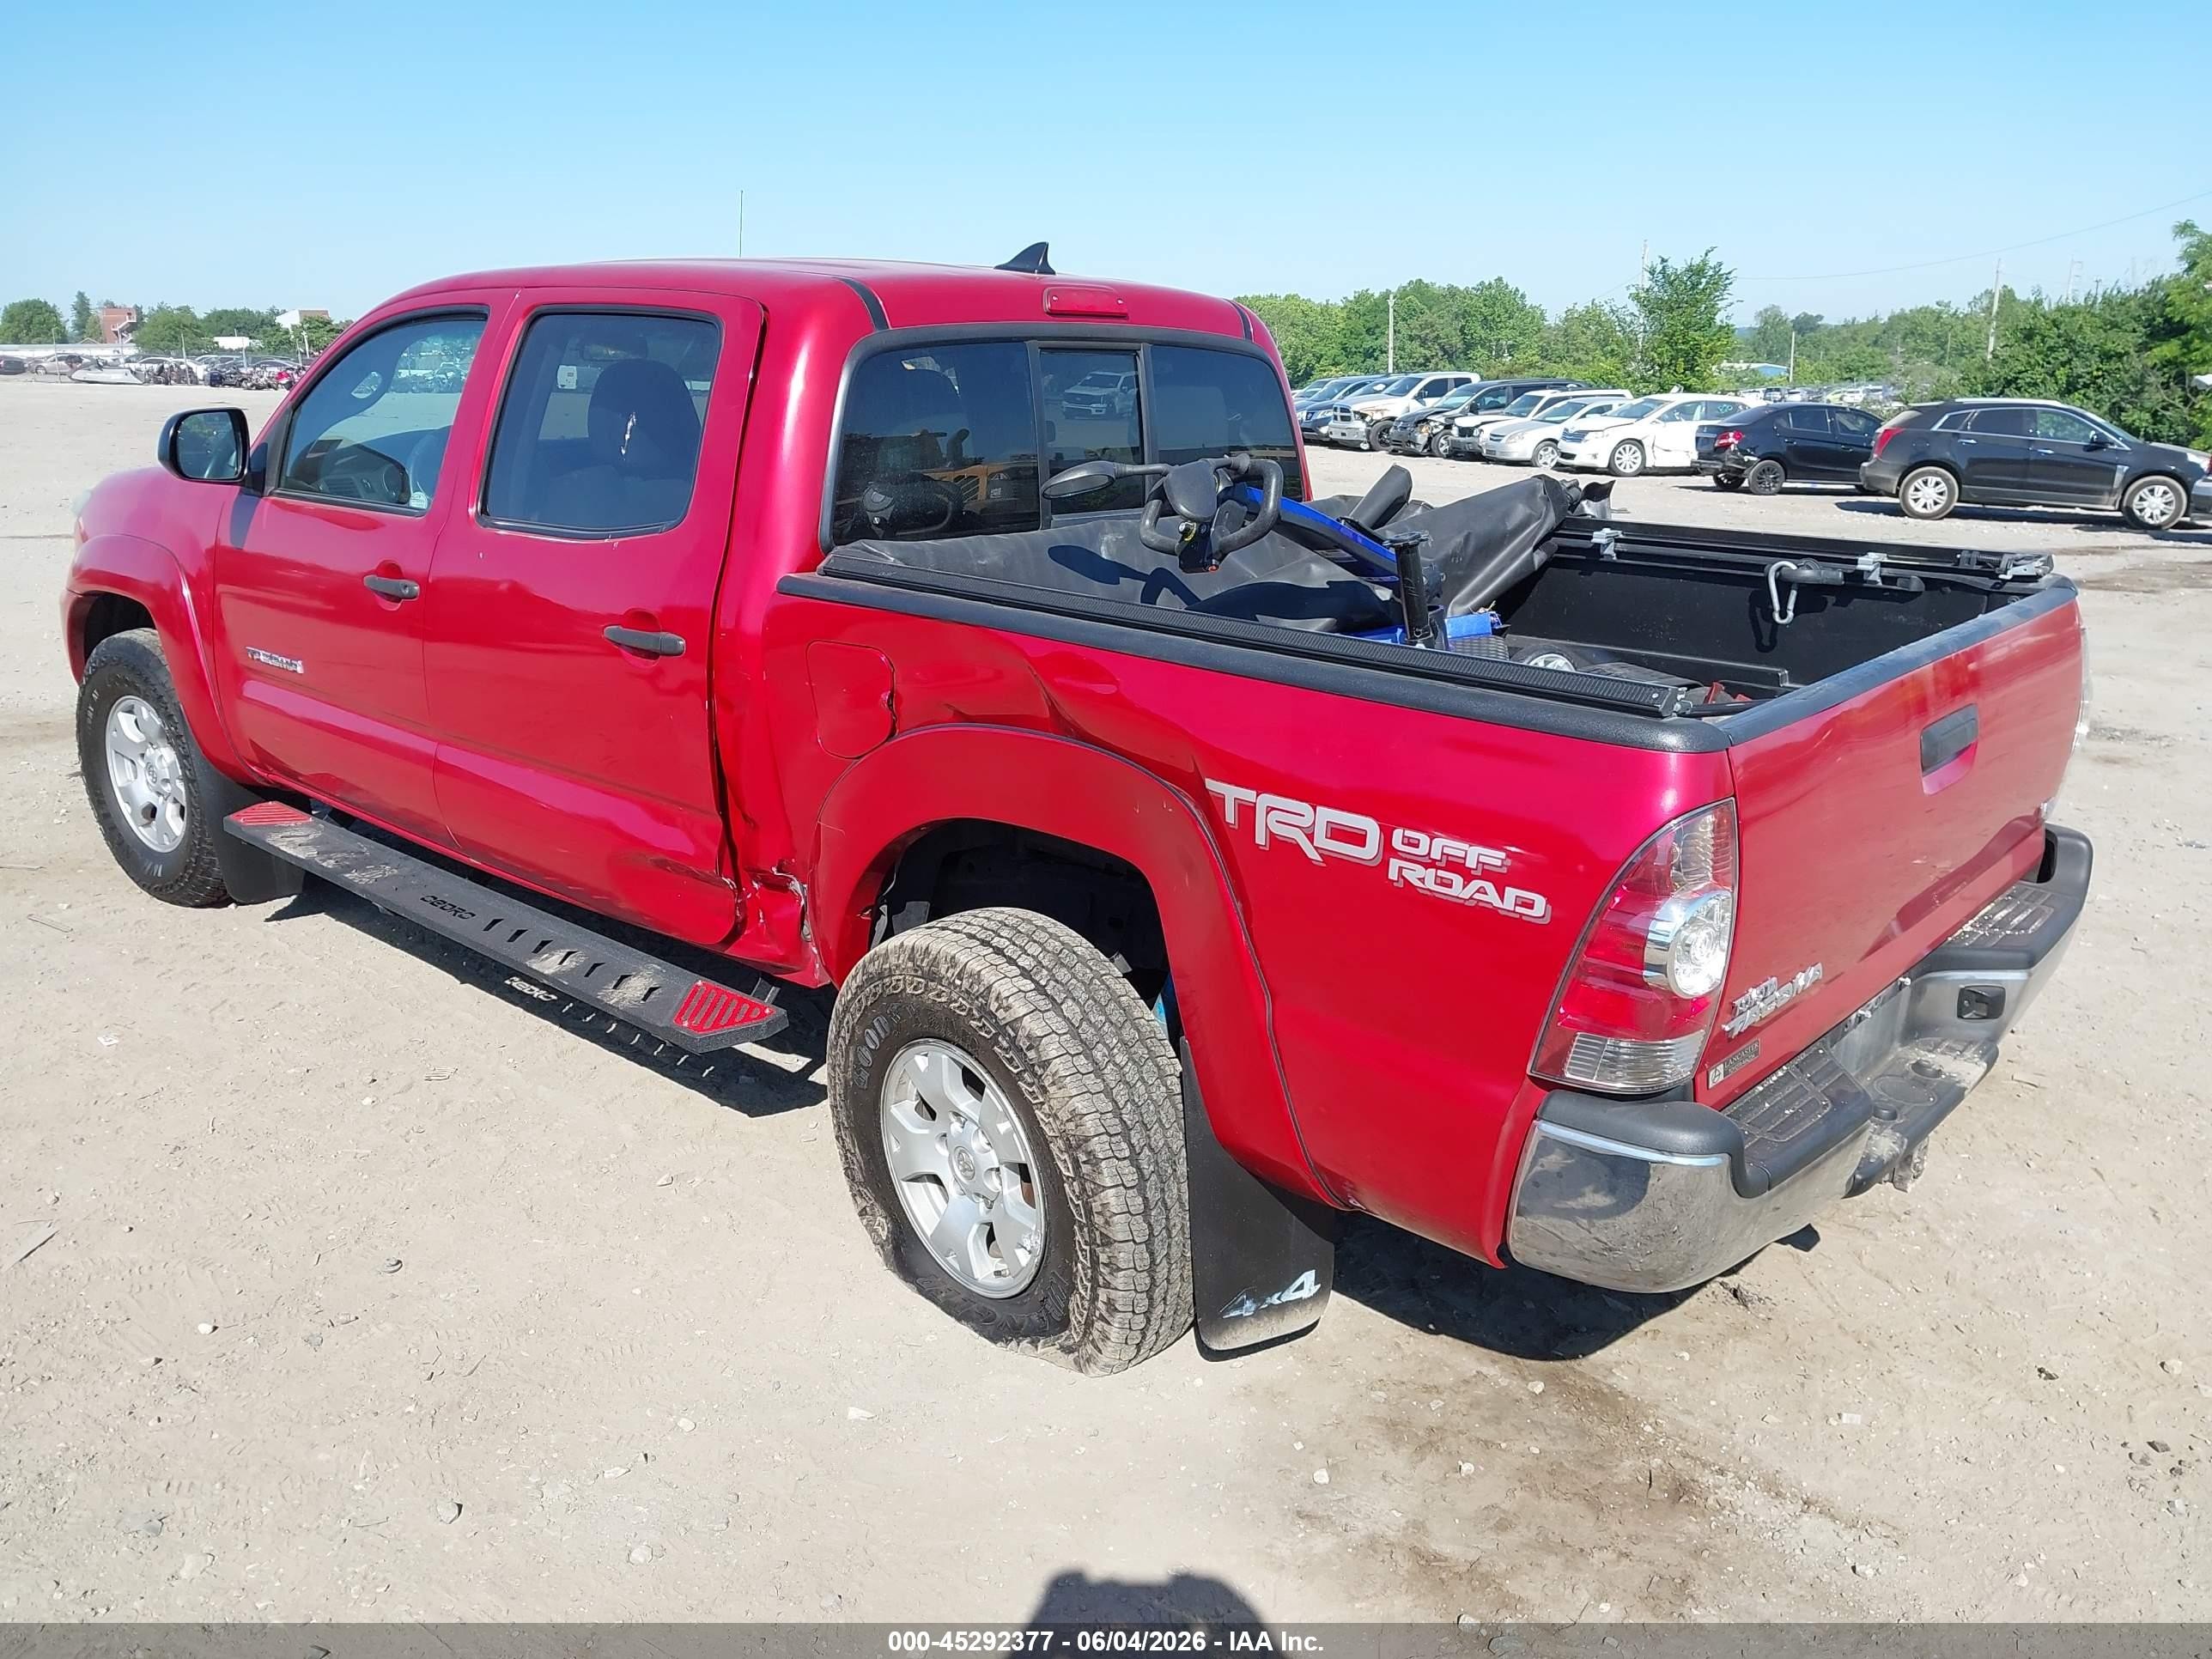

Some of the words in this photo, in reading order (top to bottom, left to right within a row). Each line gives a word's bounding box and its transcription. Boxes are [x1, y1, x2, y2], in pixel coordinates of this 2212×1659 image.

[1205, 778, 1383, 866] TRD
[1391, 828, 1510, 875] OFF
[1388, 860, 1551, 925] ROAD
[1724, 1042, 1759, 1068] LANCASTER
